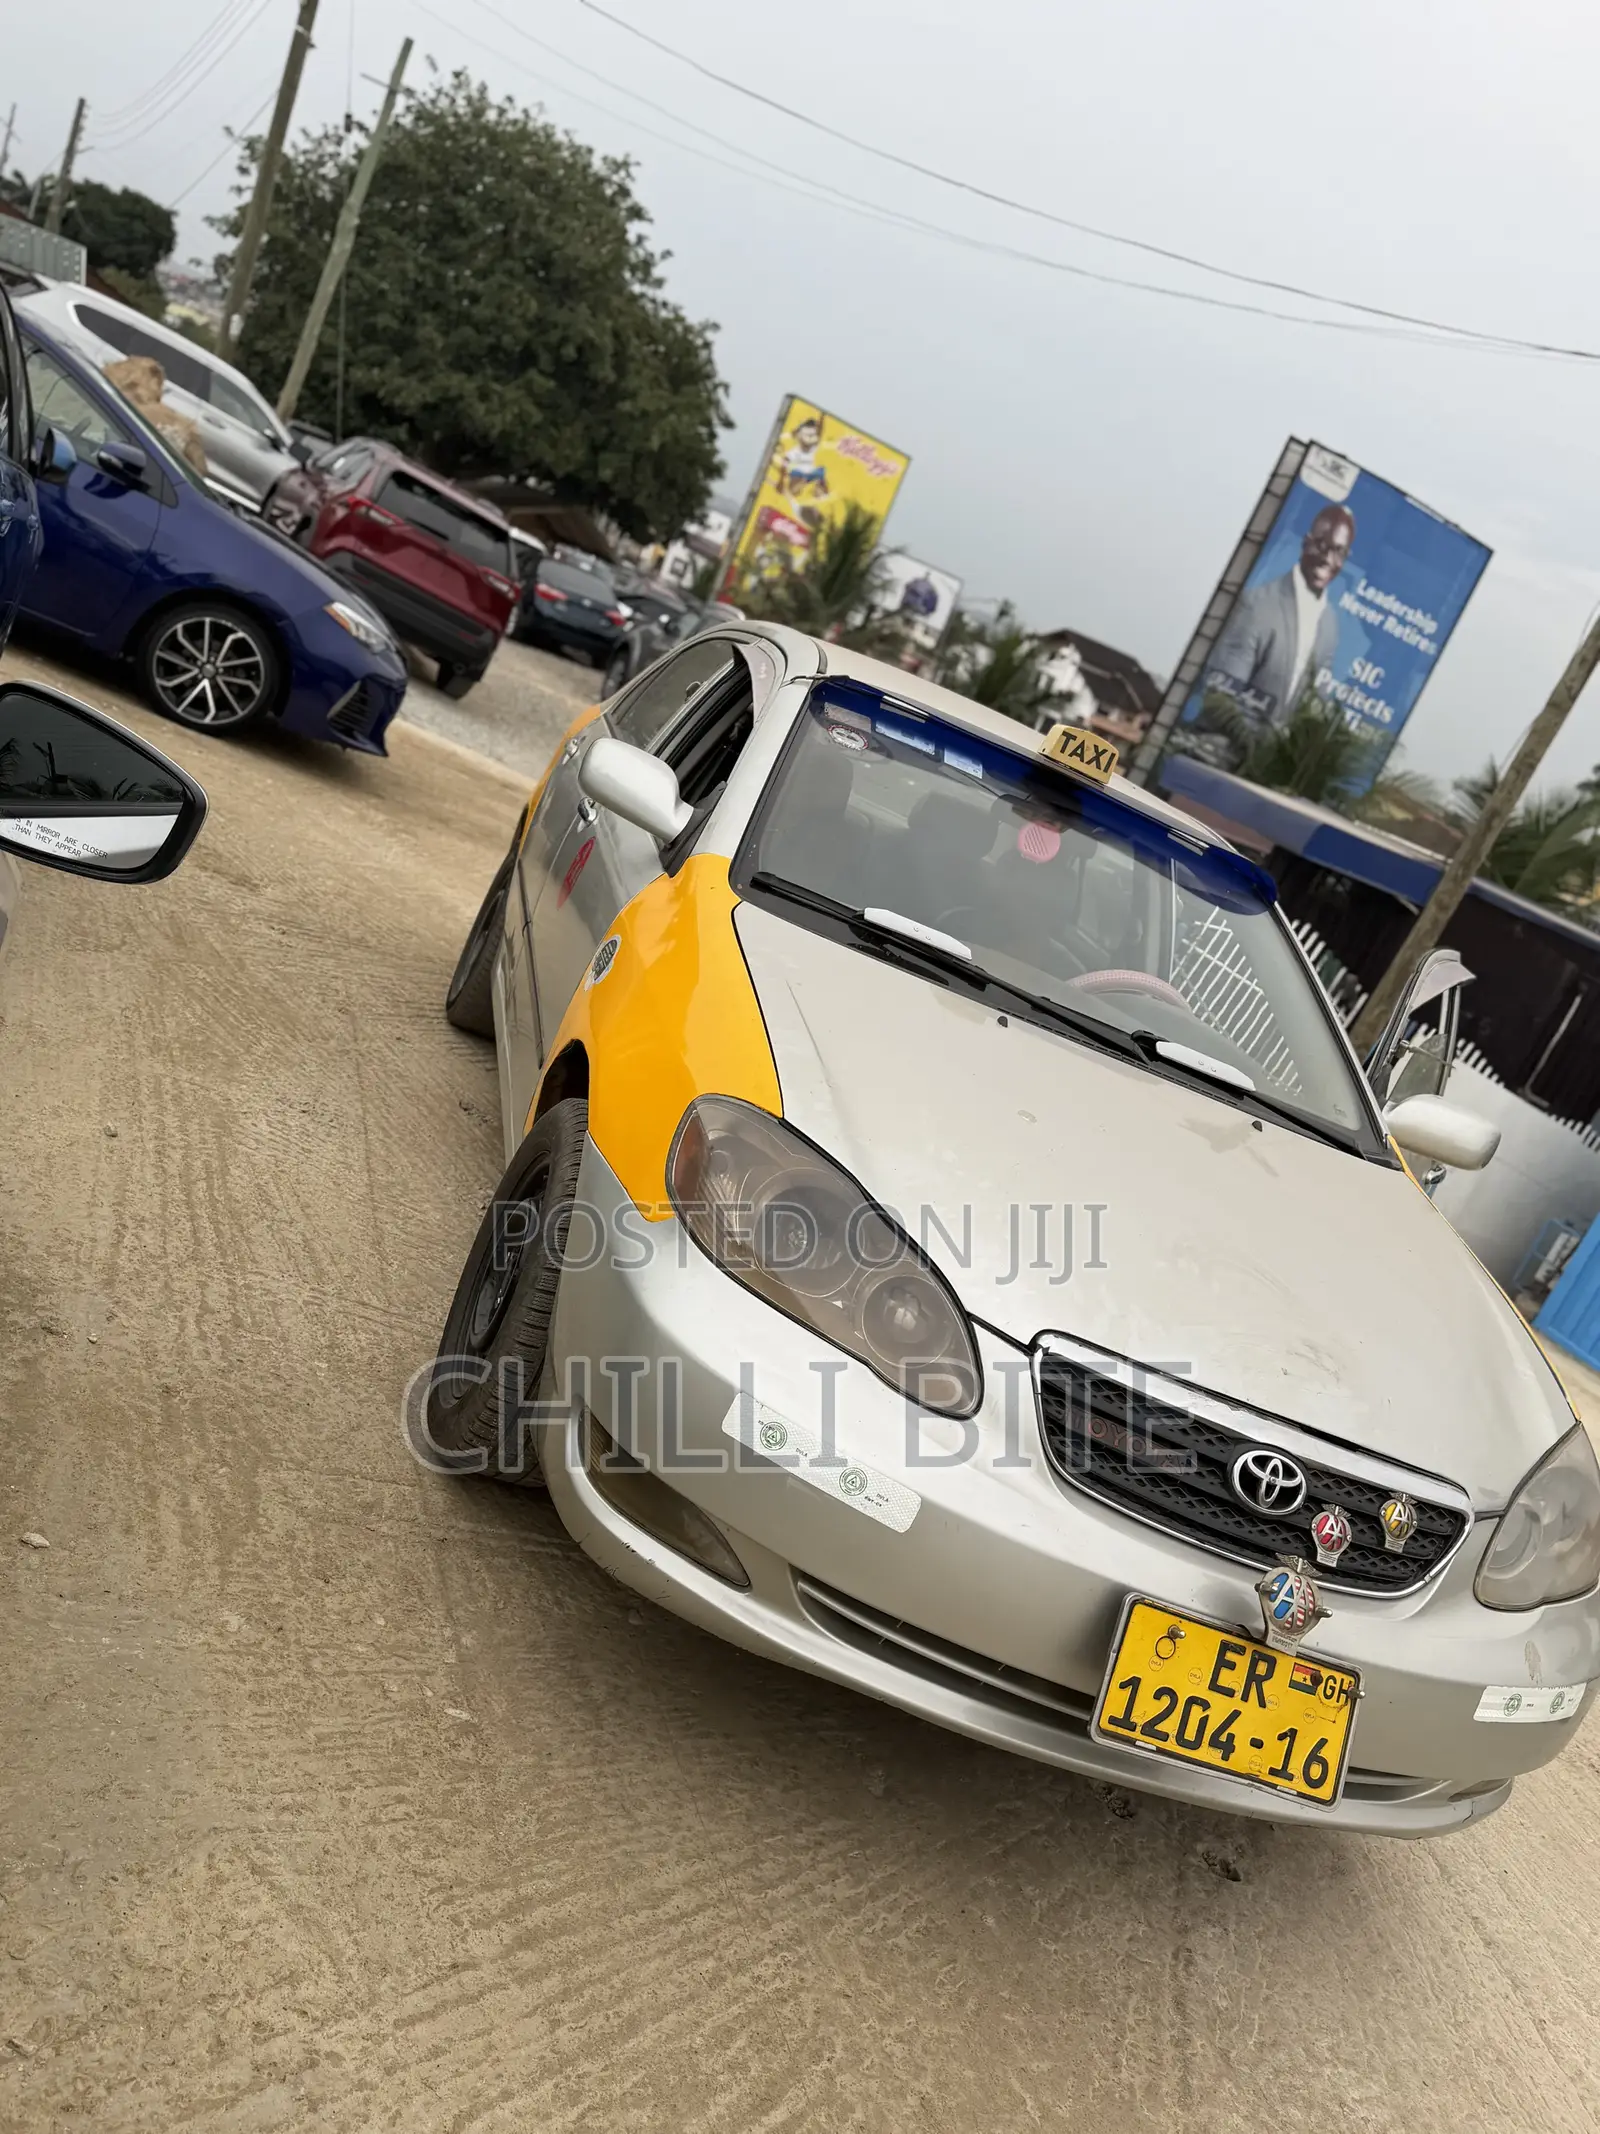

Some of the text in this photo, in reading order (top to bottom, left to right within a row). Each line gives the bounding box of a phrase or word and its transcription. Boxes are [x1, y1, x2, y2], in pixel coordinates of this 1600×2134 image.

[1357, 578, 1438, 635] Leadership
[1351, 657, 1385, 689] SIC
[1060, 730, 1116, 773] TAXI
[15, 824, 82, 857] THAN THEY APPEAR
[25, 819, 108, 859] IN MIRROR ARE CLOSER
[1208, 1639, 1353, 1708] ER GH
[1108, 1676, 1329, 1788] 1204-16
